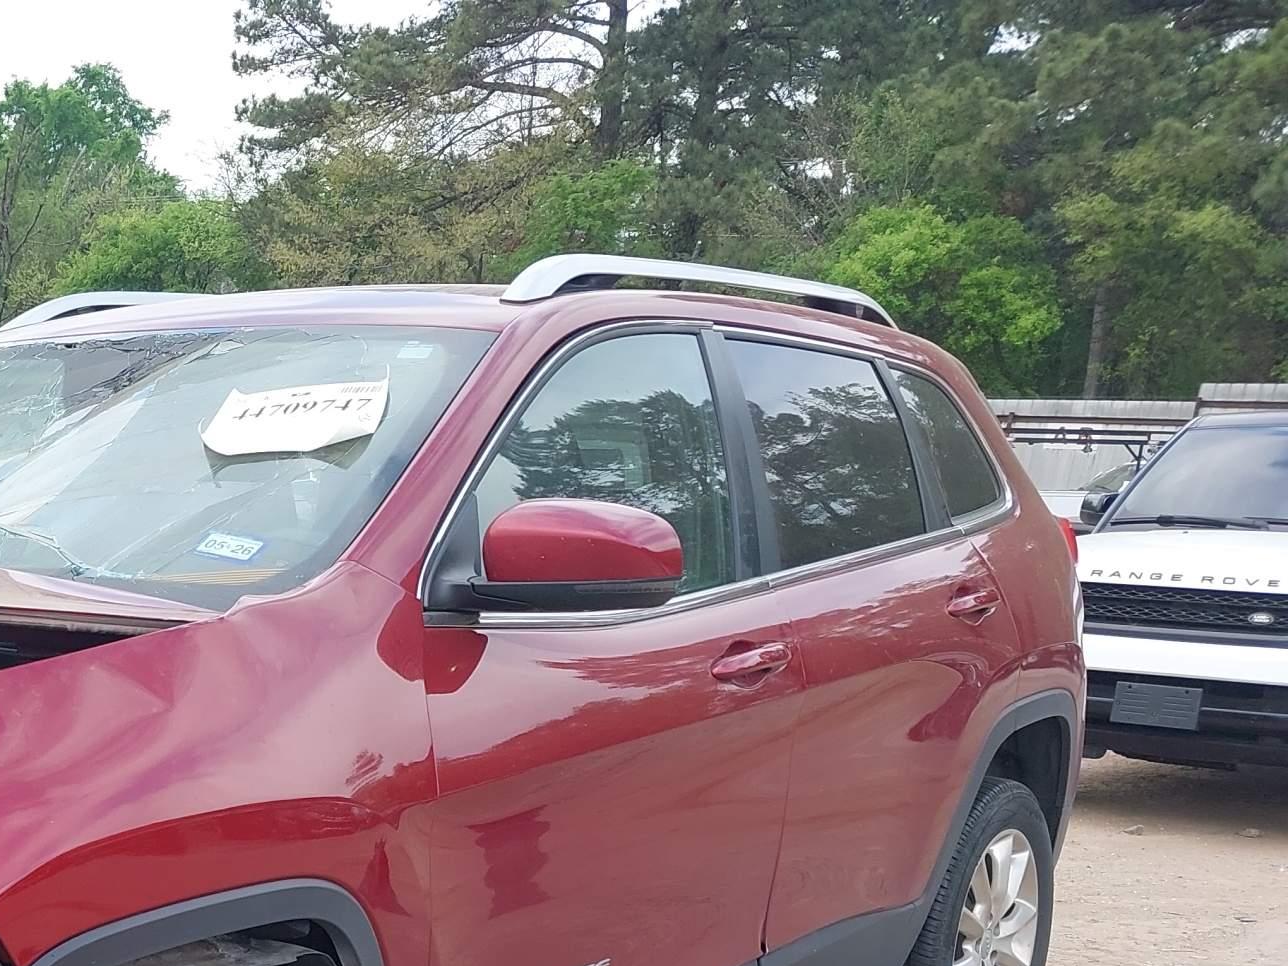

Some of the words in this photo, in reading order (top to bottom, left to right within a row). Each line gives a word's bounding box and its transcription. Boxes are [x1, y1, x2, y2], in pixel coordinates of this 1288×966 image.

[233, 397, 372, 420] 44709747
[1090, 569, 1183, 582] RANGE
[1200, 575, 1288, 588] ROVE
